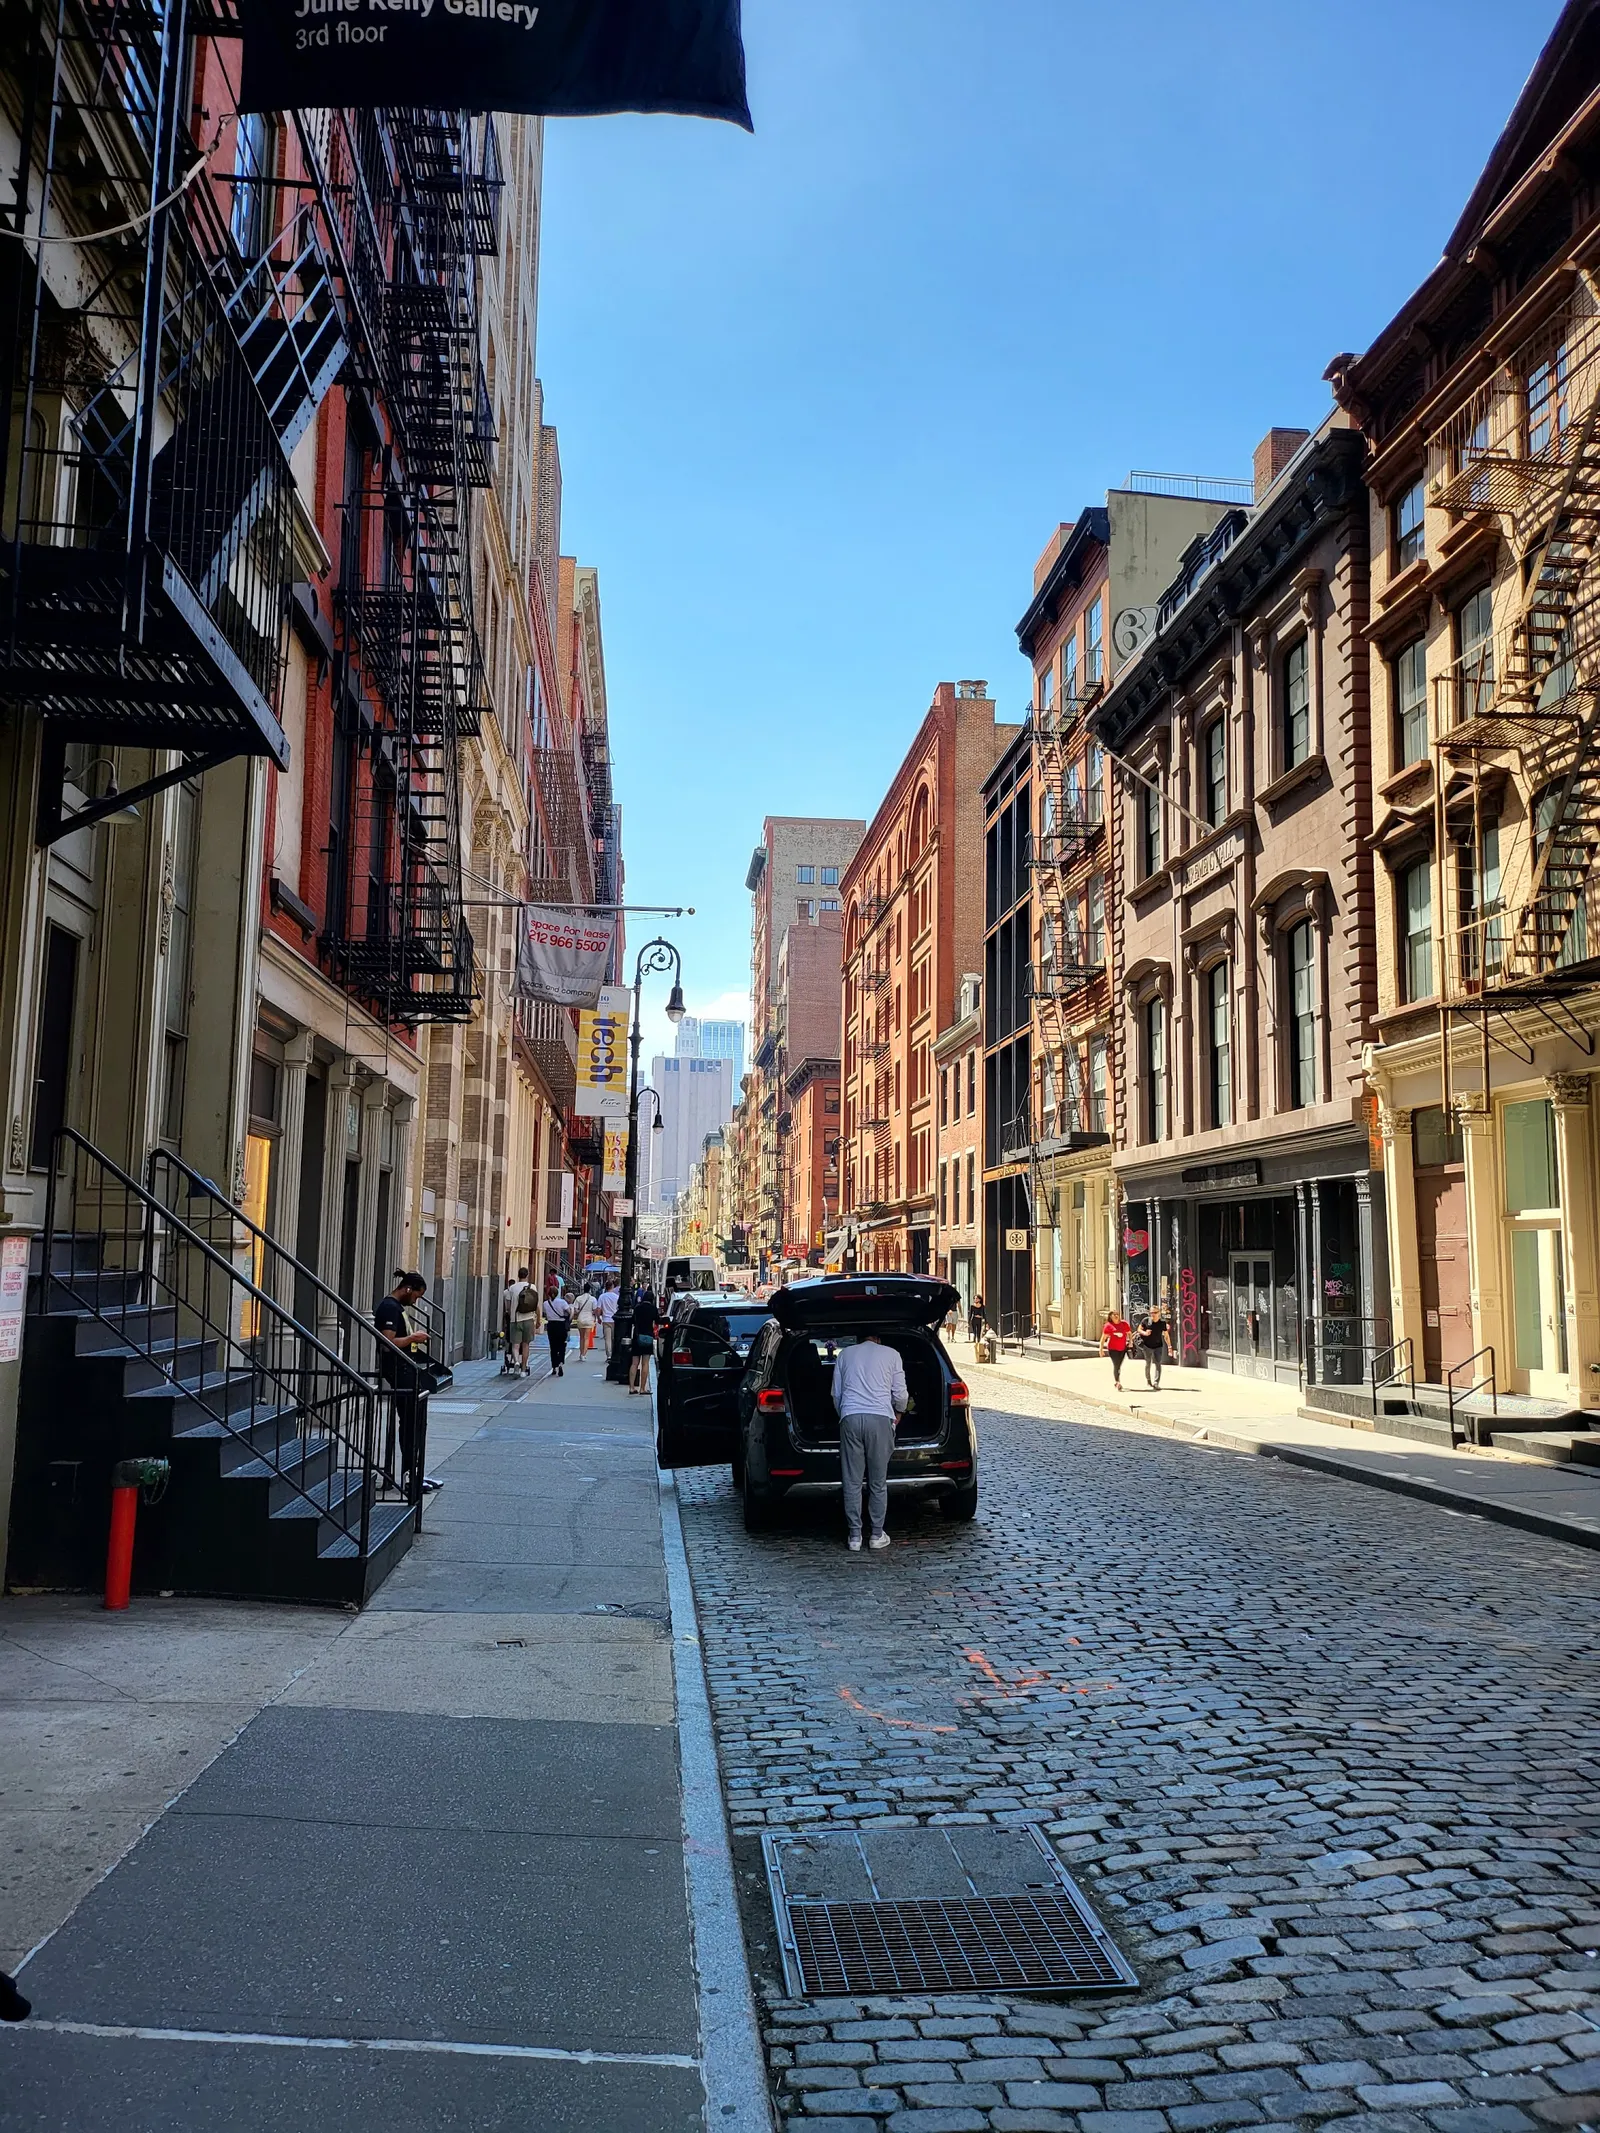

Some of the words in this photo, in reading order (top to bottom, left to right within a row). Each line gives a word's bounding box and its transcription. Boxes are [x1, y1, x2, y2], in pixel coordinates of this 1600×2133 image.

[443, 0, 539, 30] Gallery
[296, 23, 329, 49] 3rd
[336, 21, 388, 43] floor
[528, 930, 548, 944] 212
[549, 934, 573, 949] 966
[575, 939, 606, 952] 5500
[530, 920, 560, 933] space
[563, 926, 581, 936] for
[583, 928, 610, 939] lease
[545, 984, 560, 993] and
[561, 988, 596, 999] company
[589, 1017, 623, 1082] tech
